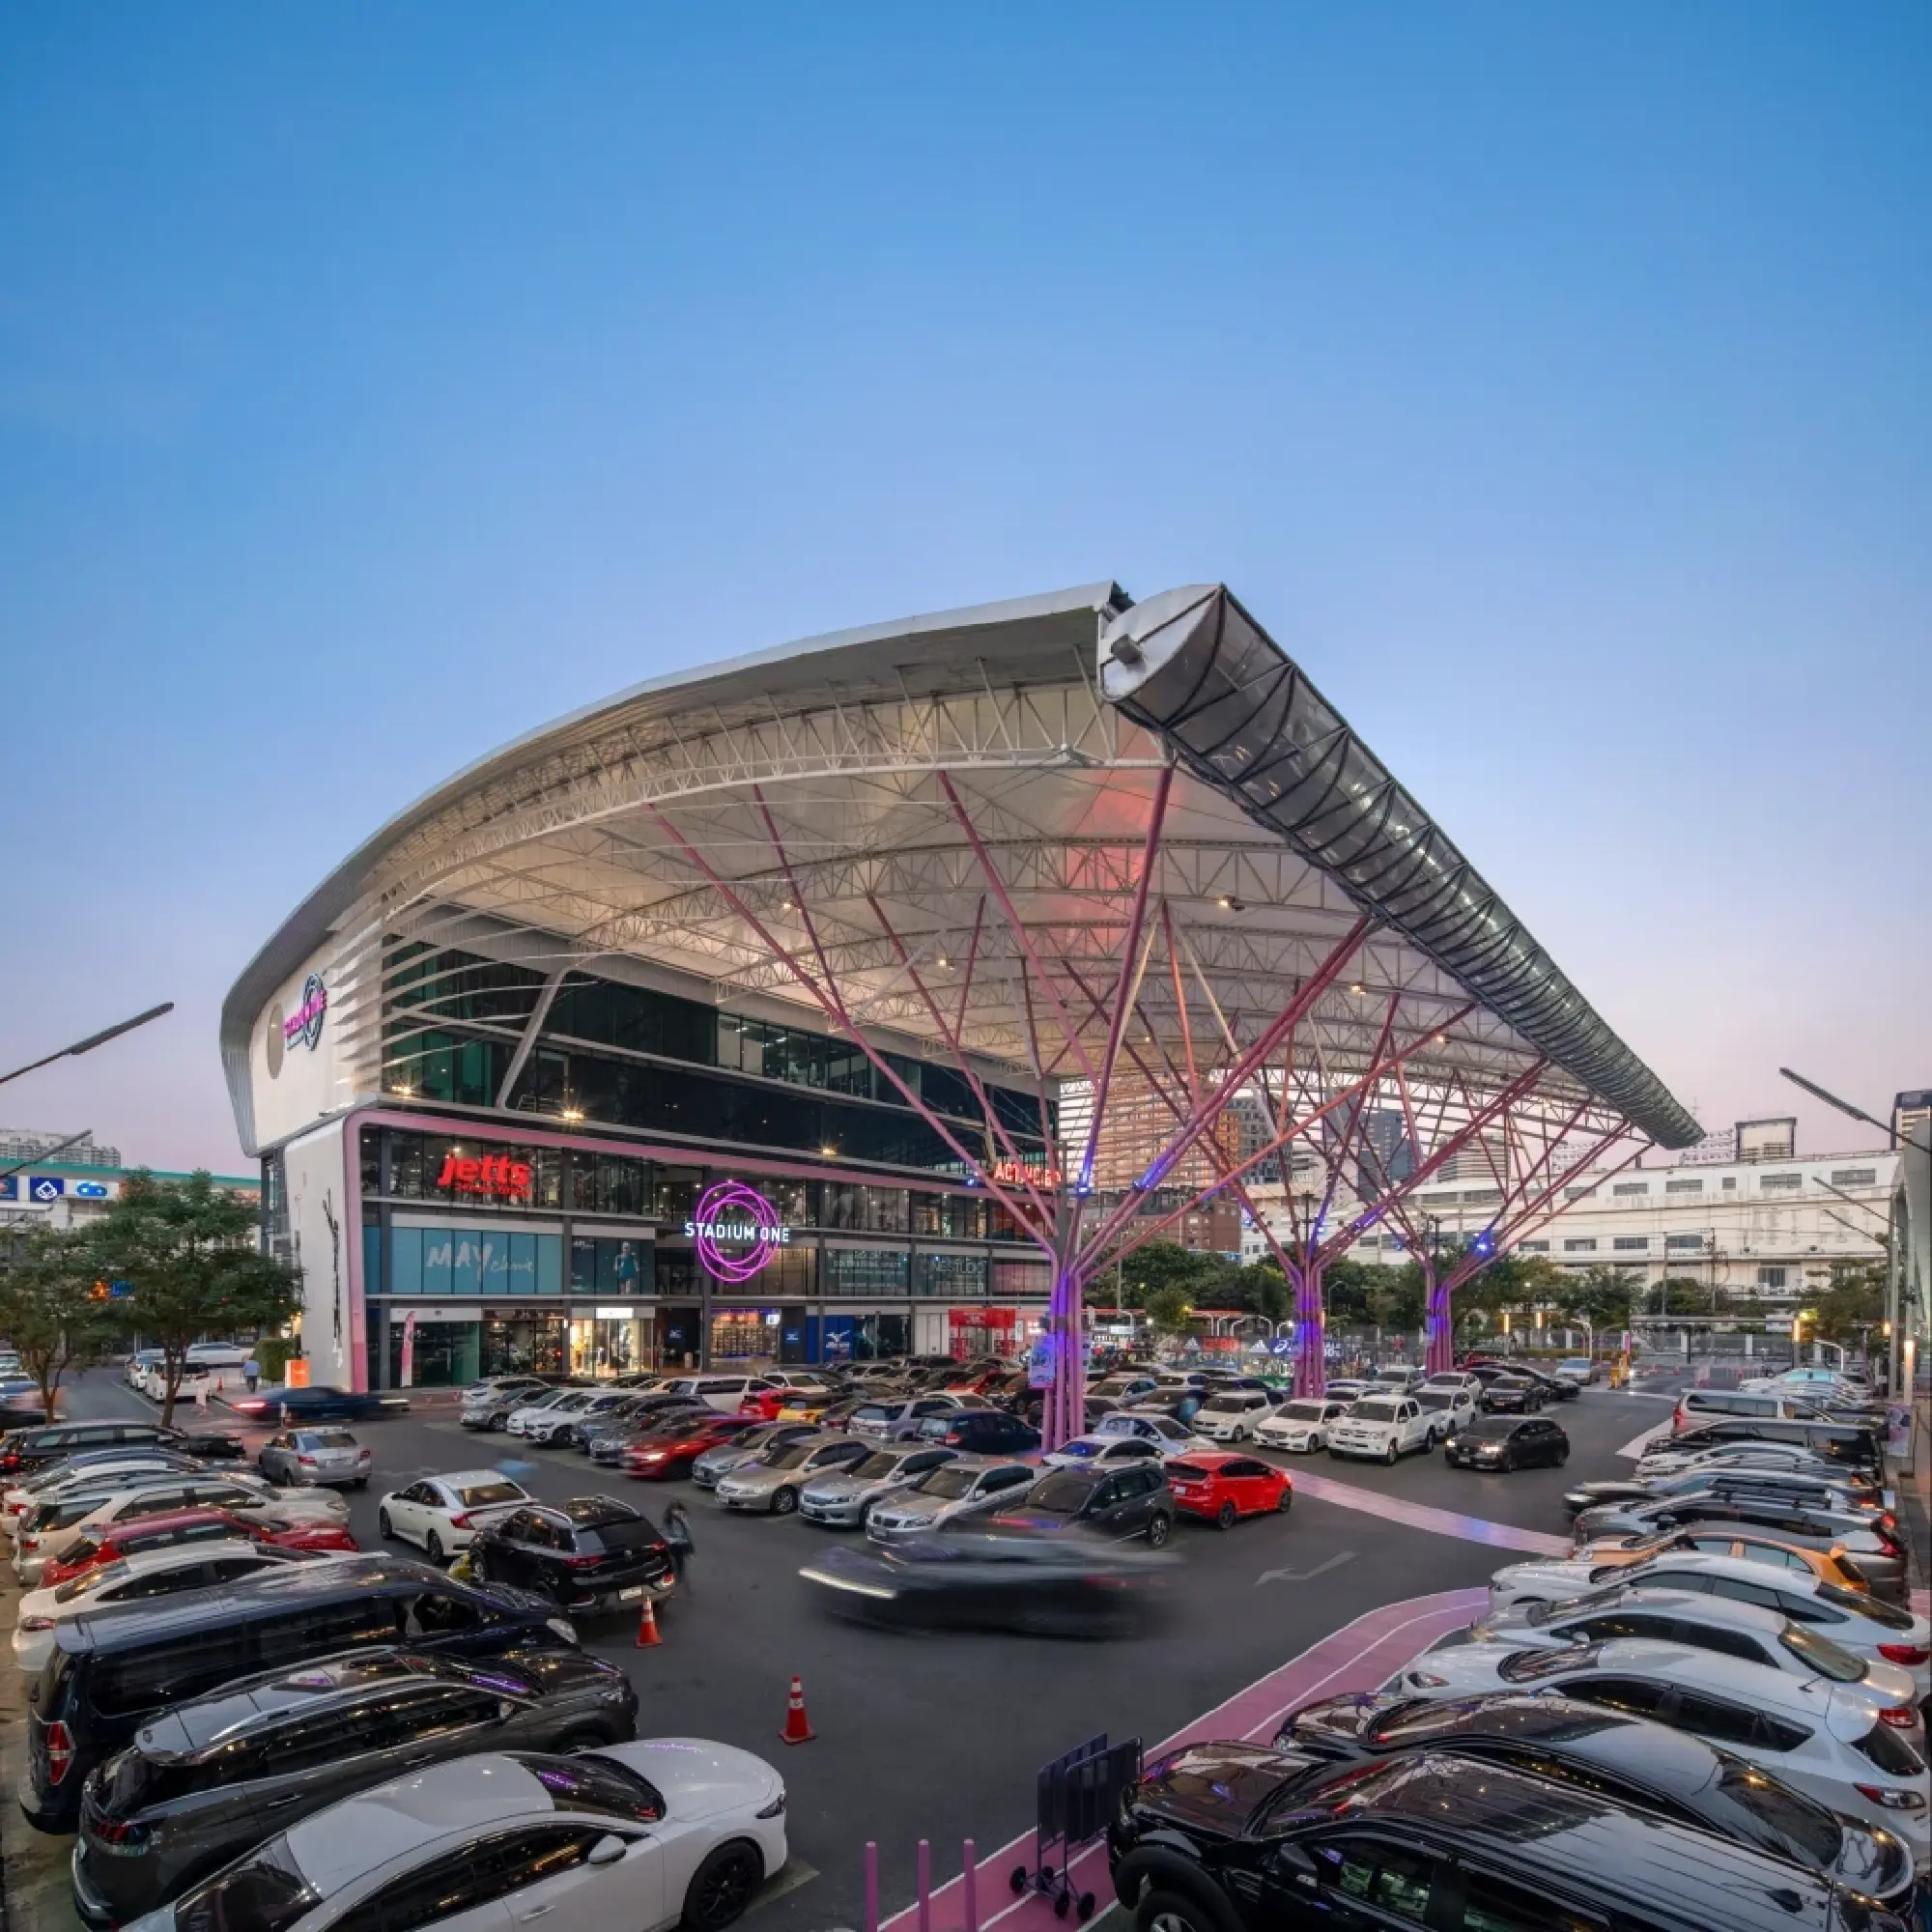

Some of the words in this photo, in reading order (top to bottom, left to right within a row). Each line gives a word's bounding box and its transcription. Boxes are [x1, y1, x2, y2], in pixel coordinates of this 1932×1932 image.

[437, 1151, 530, 1186] jetts
[684, 1222, 755, 1240] STADIUM
[759, 1226, 790, 1242] ONE
[425, 1240, 494, 1284] MAY
